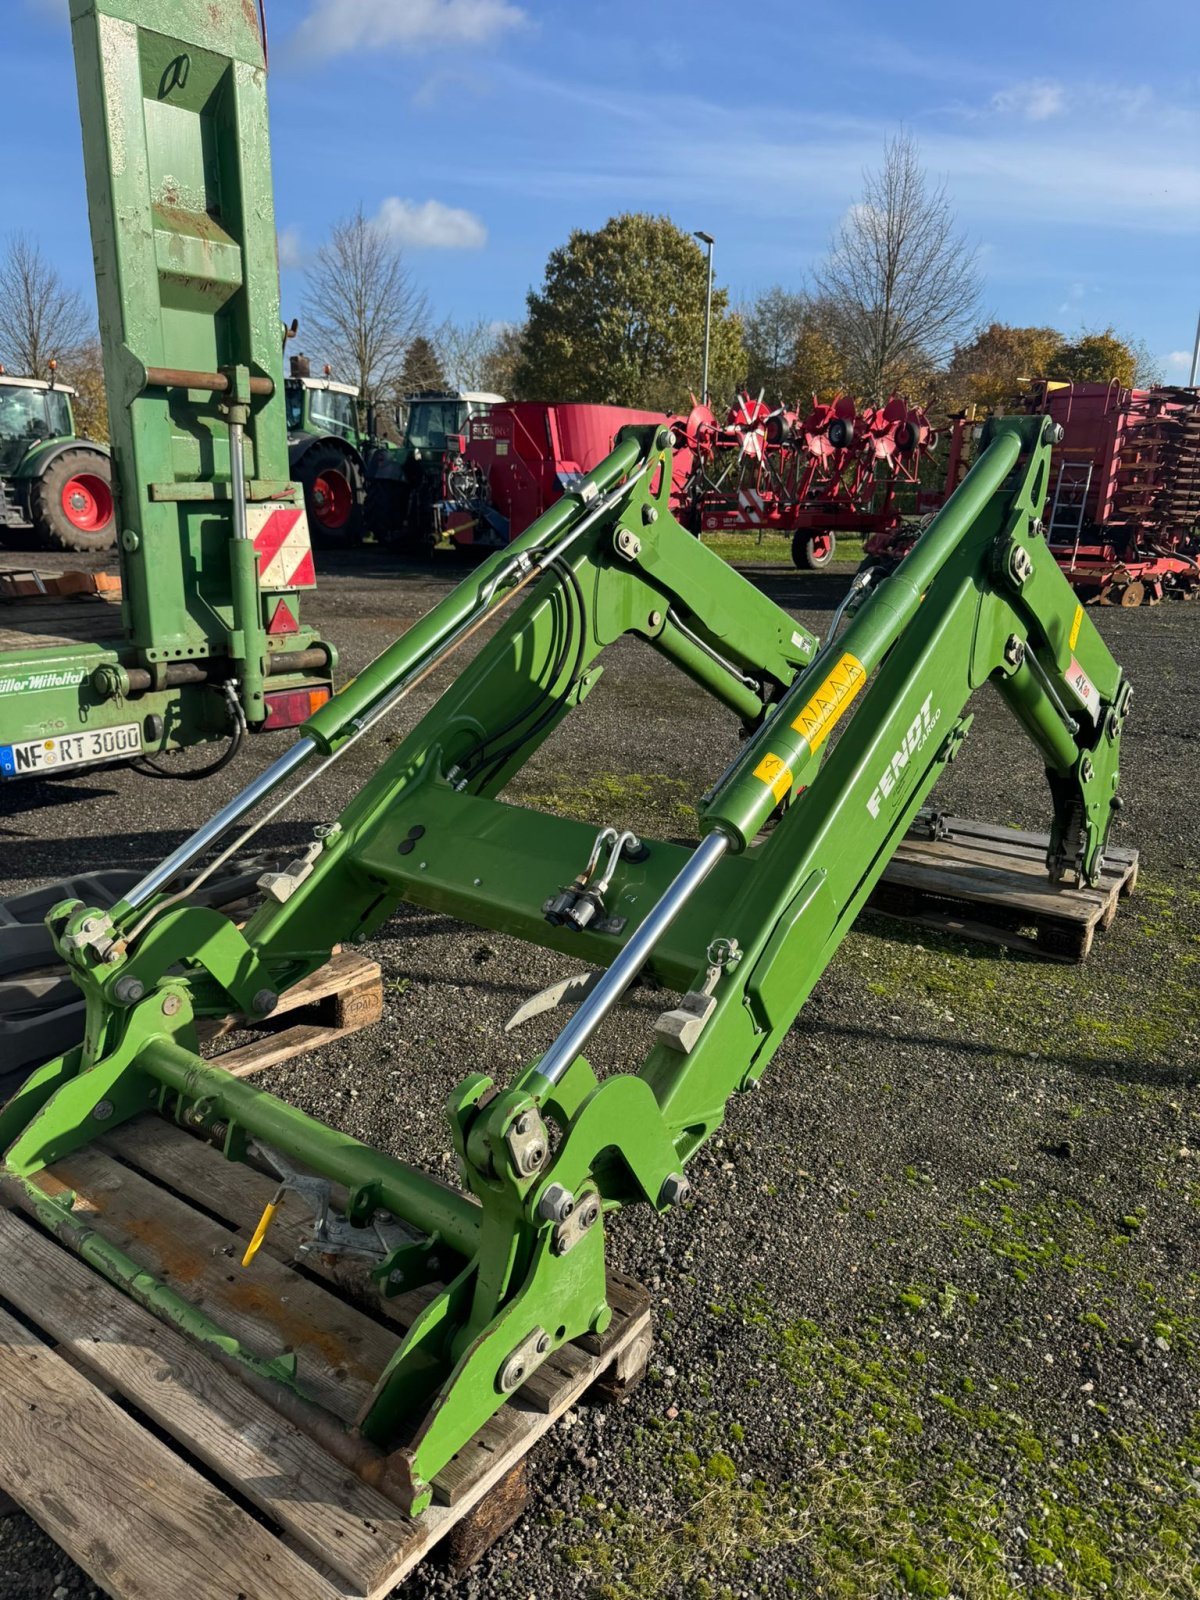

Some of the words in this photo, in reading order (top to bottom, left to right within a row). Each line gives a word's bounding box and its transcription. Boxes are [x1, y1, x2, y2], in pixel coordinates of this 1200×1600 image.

[28, 670, 85, 690] Mitteltal
[15, 744, 42, 770] NF
[60, 736, 84, 761] RT
[90, 727, 139, 755] 3000
[917, 708, 941, 751] CARGO
[866, 689, 933, 820] FENDT
